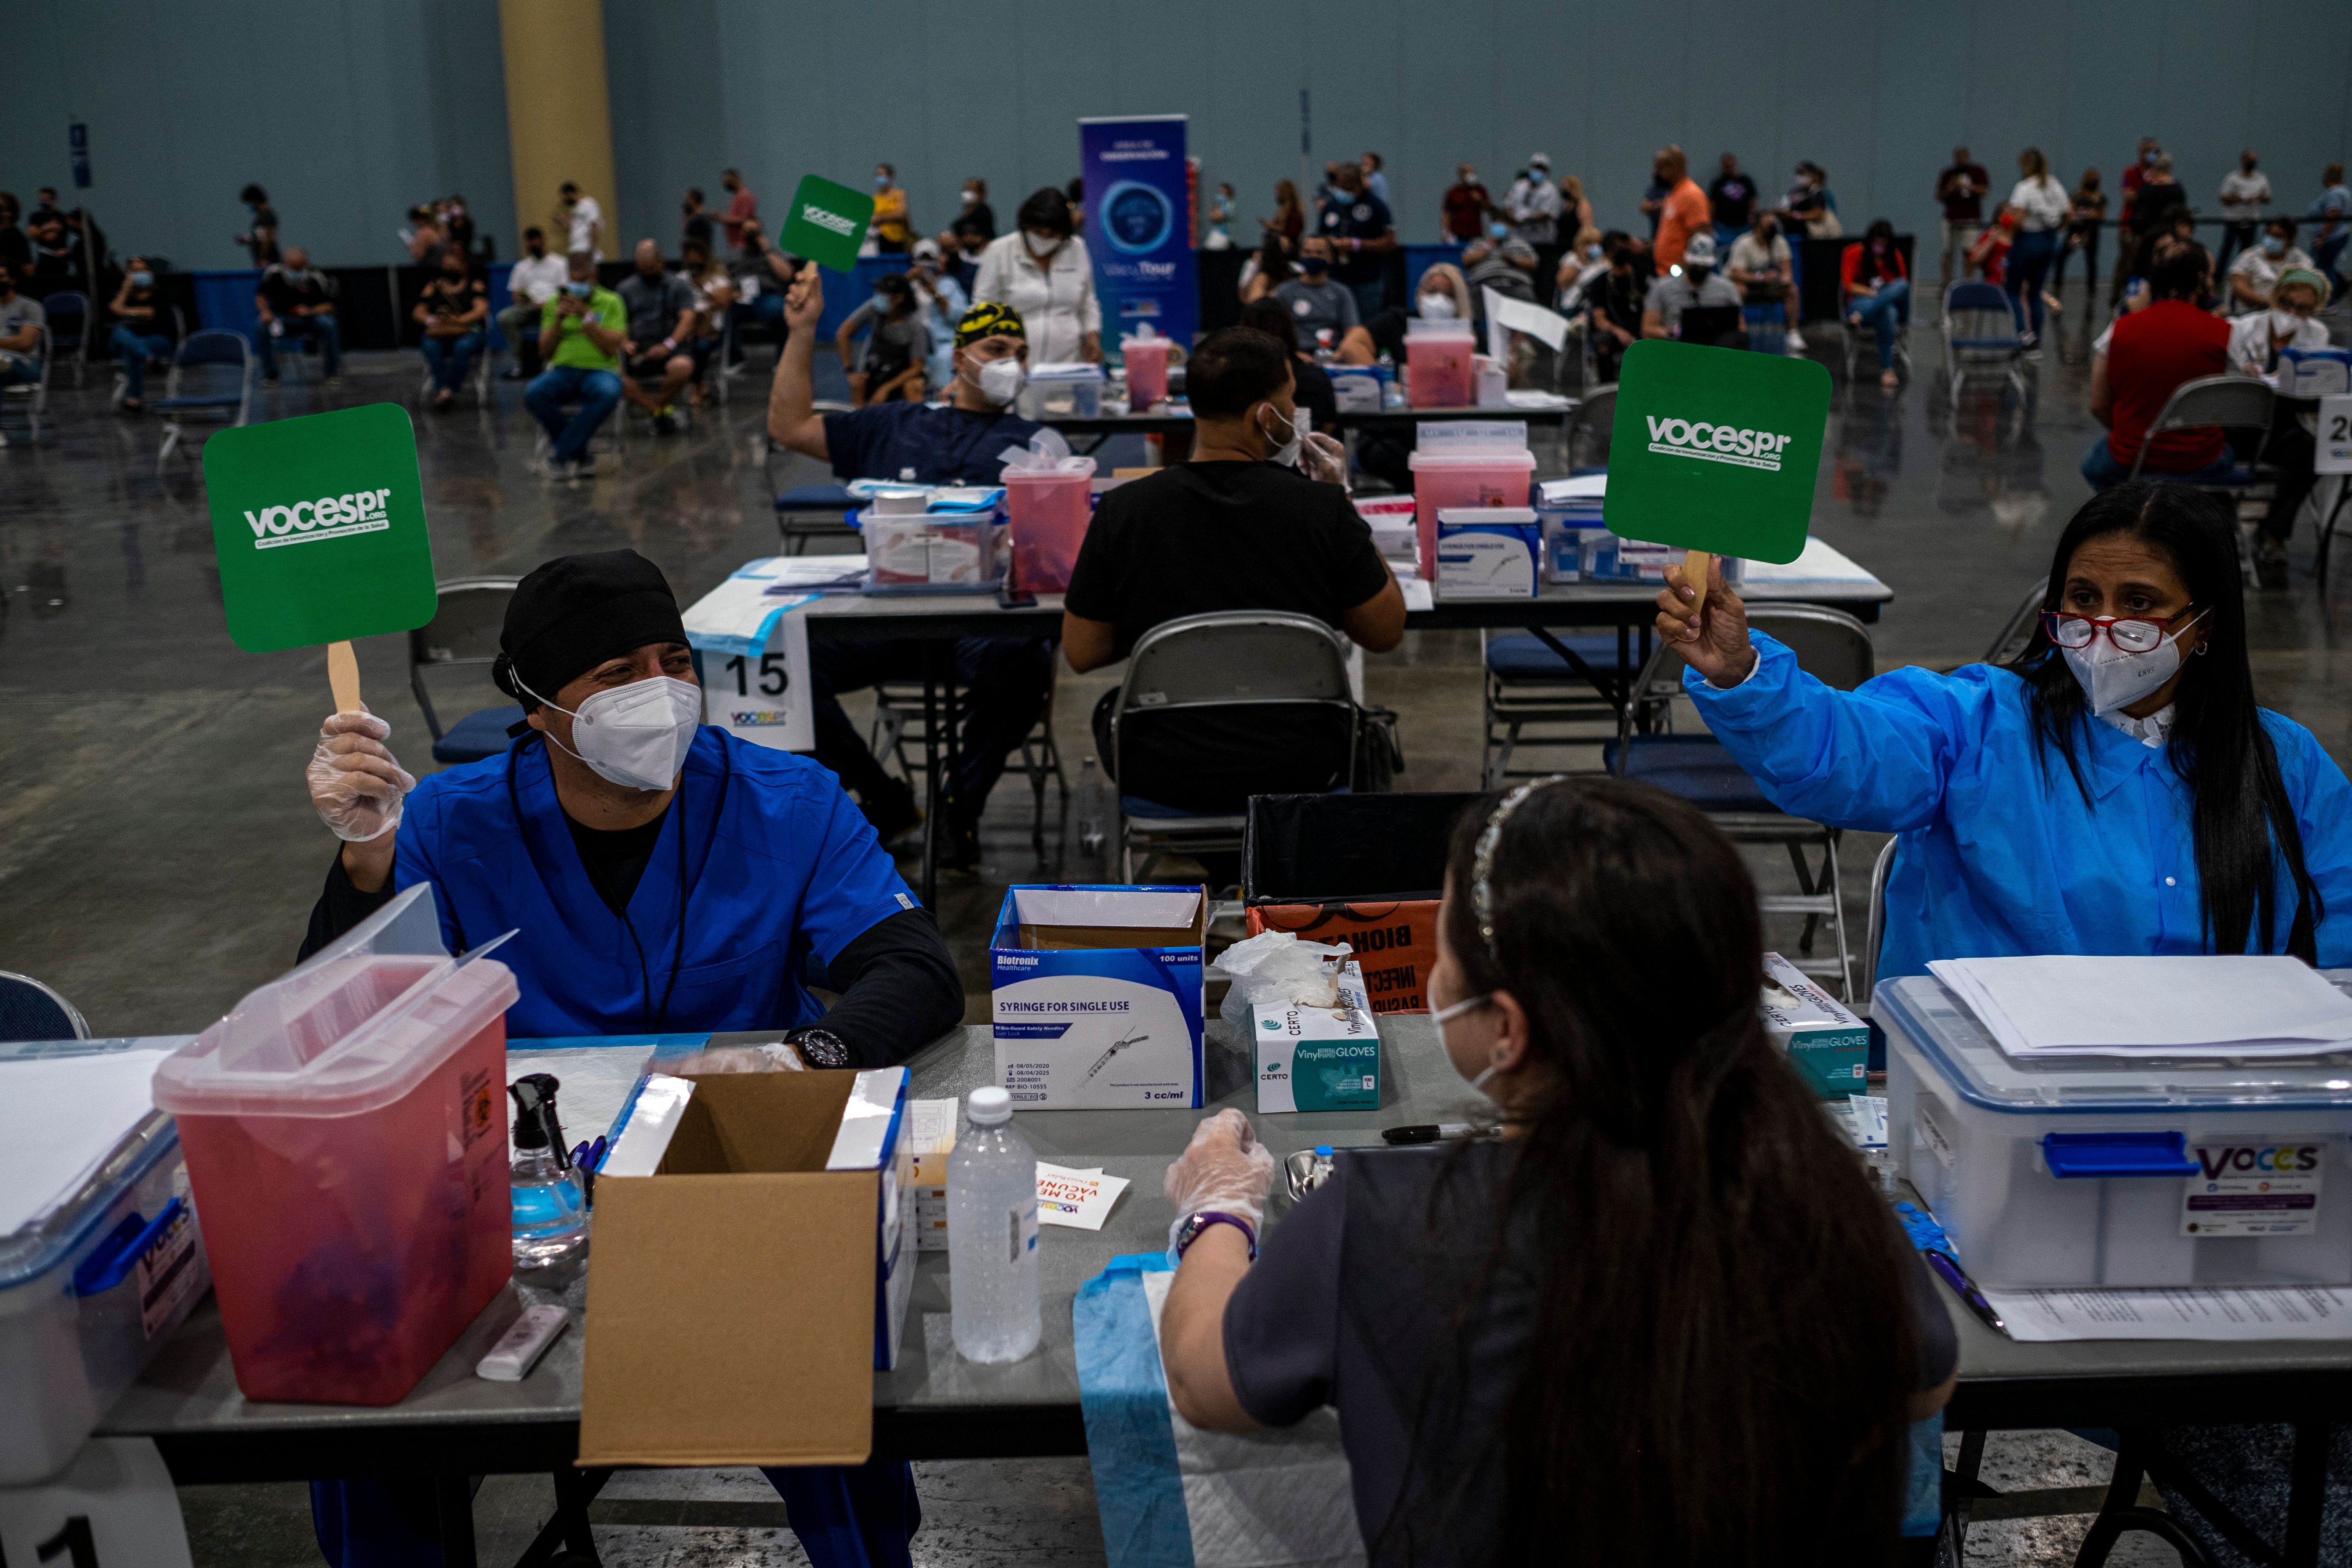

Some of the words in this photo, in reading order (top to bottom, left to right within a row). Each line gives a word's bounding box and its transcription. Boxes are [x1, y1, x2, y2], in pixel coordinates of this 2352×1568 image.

[2331, 415, 2352, 440] 2
[726, 653, 788, 696] 15
[2138, 667, 2154, 677] KN95
[997, 956, 1039, 965] Biotronix
[1789, 985, 1823, 1003] GLOVES
[1000, 1002, 1045, 1011] SYRINGE
[1047, 1002, 1068, 1011] FOR
[1070, 1002, 1108, 1011] SINGLE
[1110, 1001, 1130, 1010] USE
[1763, 1005, 1792, 1027] CERTO
[1824, 1011, 1850, 1024] Vinyl
[1287, 1011, 1301, 1035] CERTO
[1346, 1019, 1364, 1035] Vinyl
[1829, 1036, 1867, 1046] GLOVES
[1297, 1048, 1320, 1061] Vinyl
[1336, 1047, 1374, 1057] GLOVES
[1154, 1091, 1183, 1099] cc/ml
[1040, 1189, 1061, 1198] ME
[1065, 1193, 1084, 1202] YO
